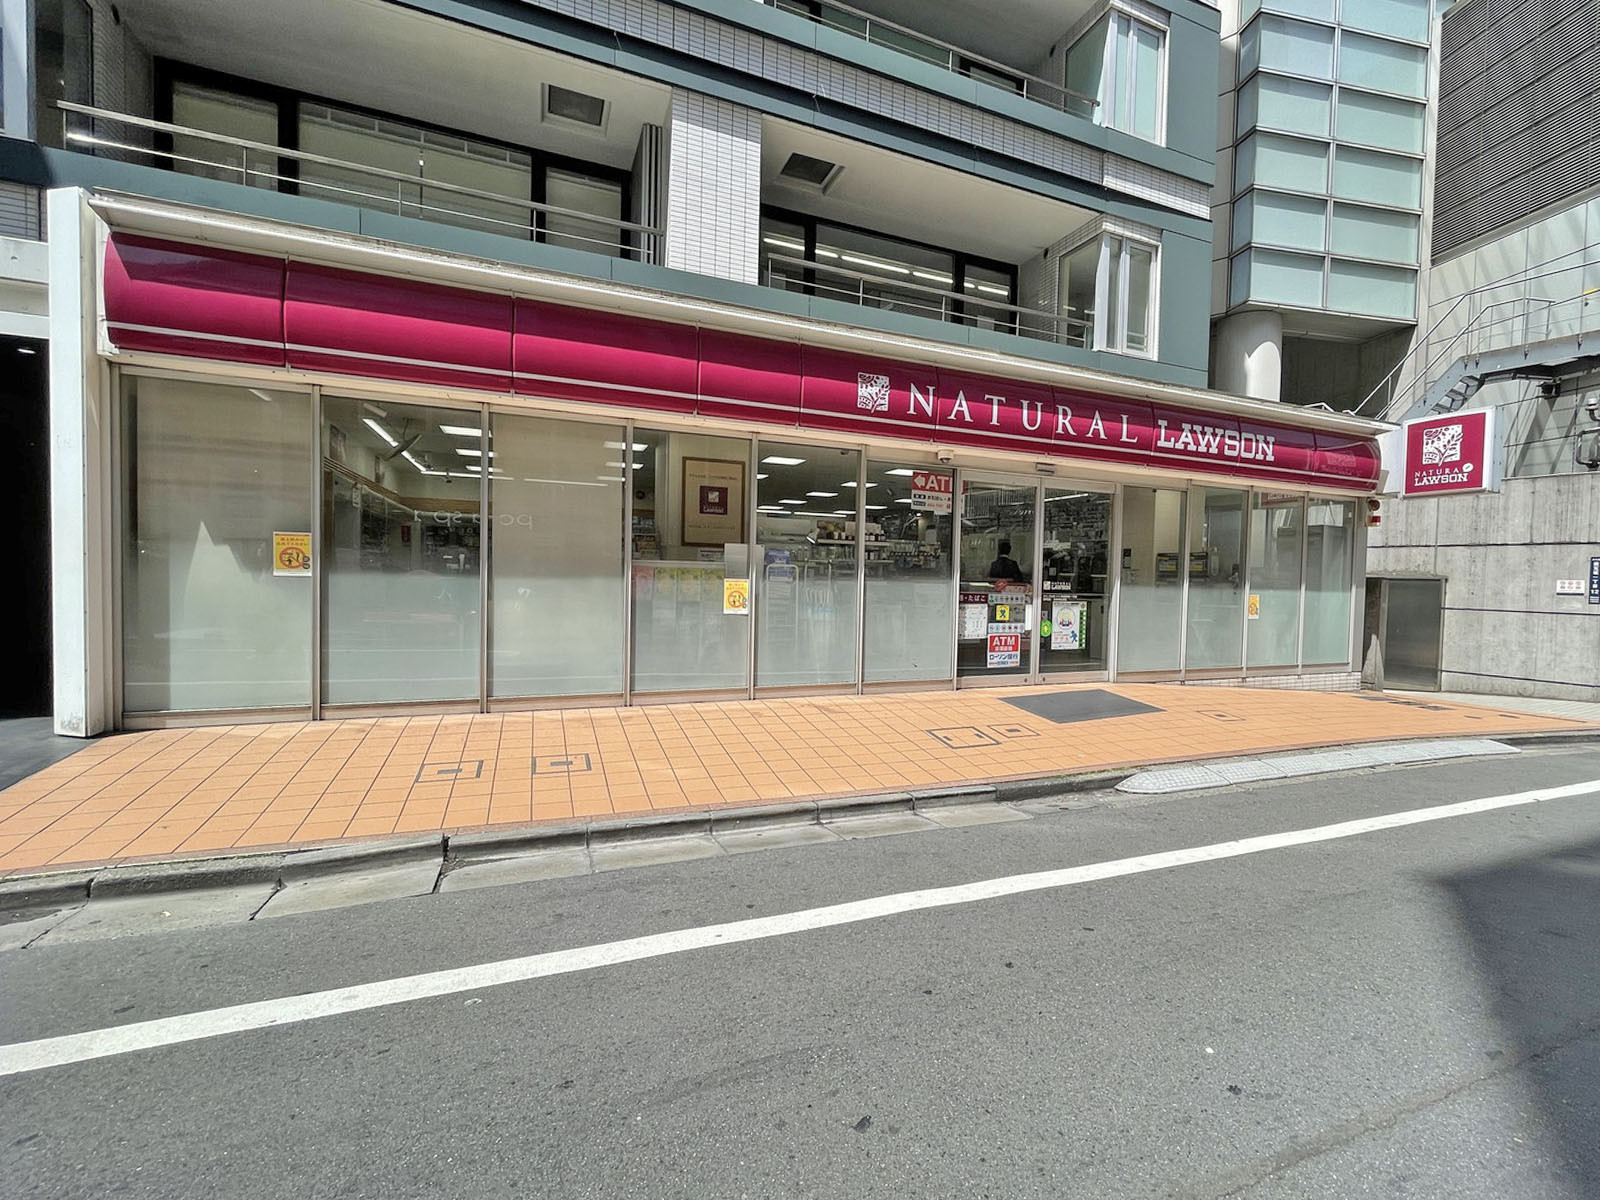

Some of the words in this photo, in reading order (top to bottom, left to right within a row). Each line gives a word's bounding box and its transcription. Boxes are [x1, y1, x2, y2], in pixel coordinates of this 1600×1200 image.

[907, 383, 1138, 444] NATURAL
[1156, 419, 1276, 462] LAWSON
[1414, 467, 1460, 478] NATURA
[1414, 472, 1469, 487] LAWSON
[925, 475, 952, 491] AT
[992, 636, 1016, 647] ATM
